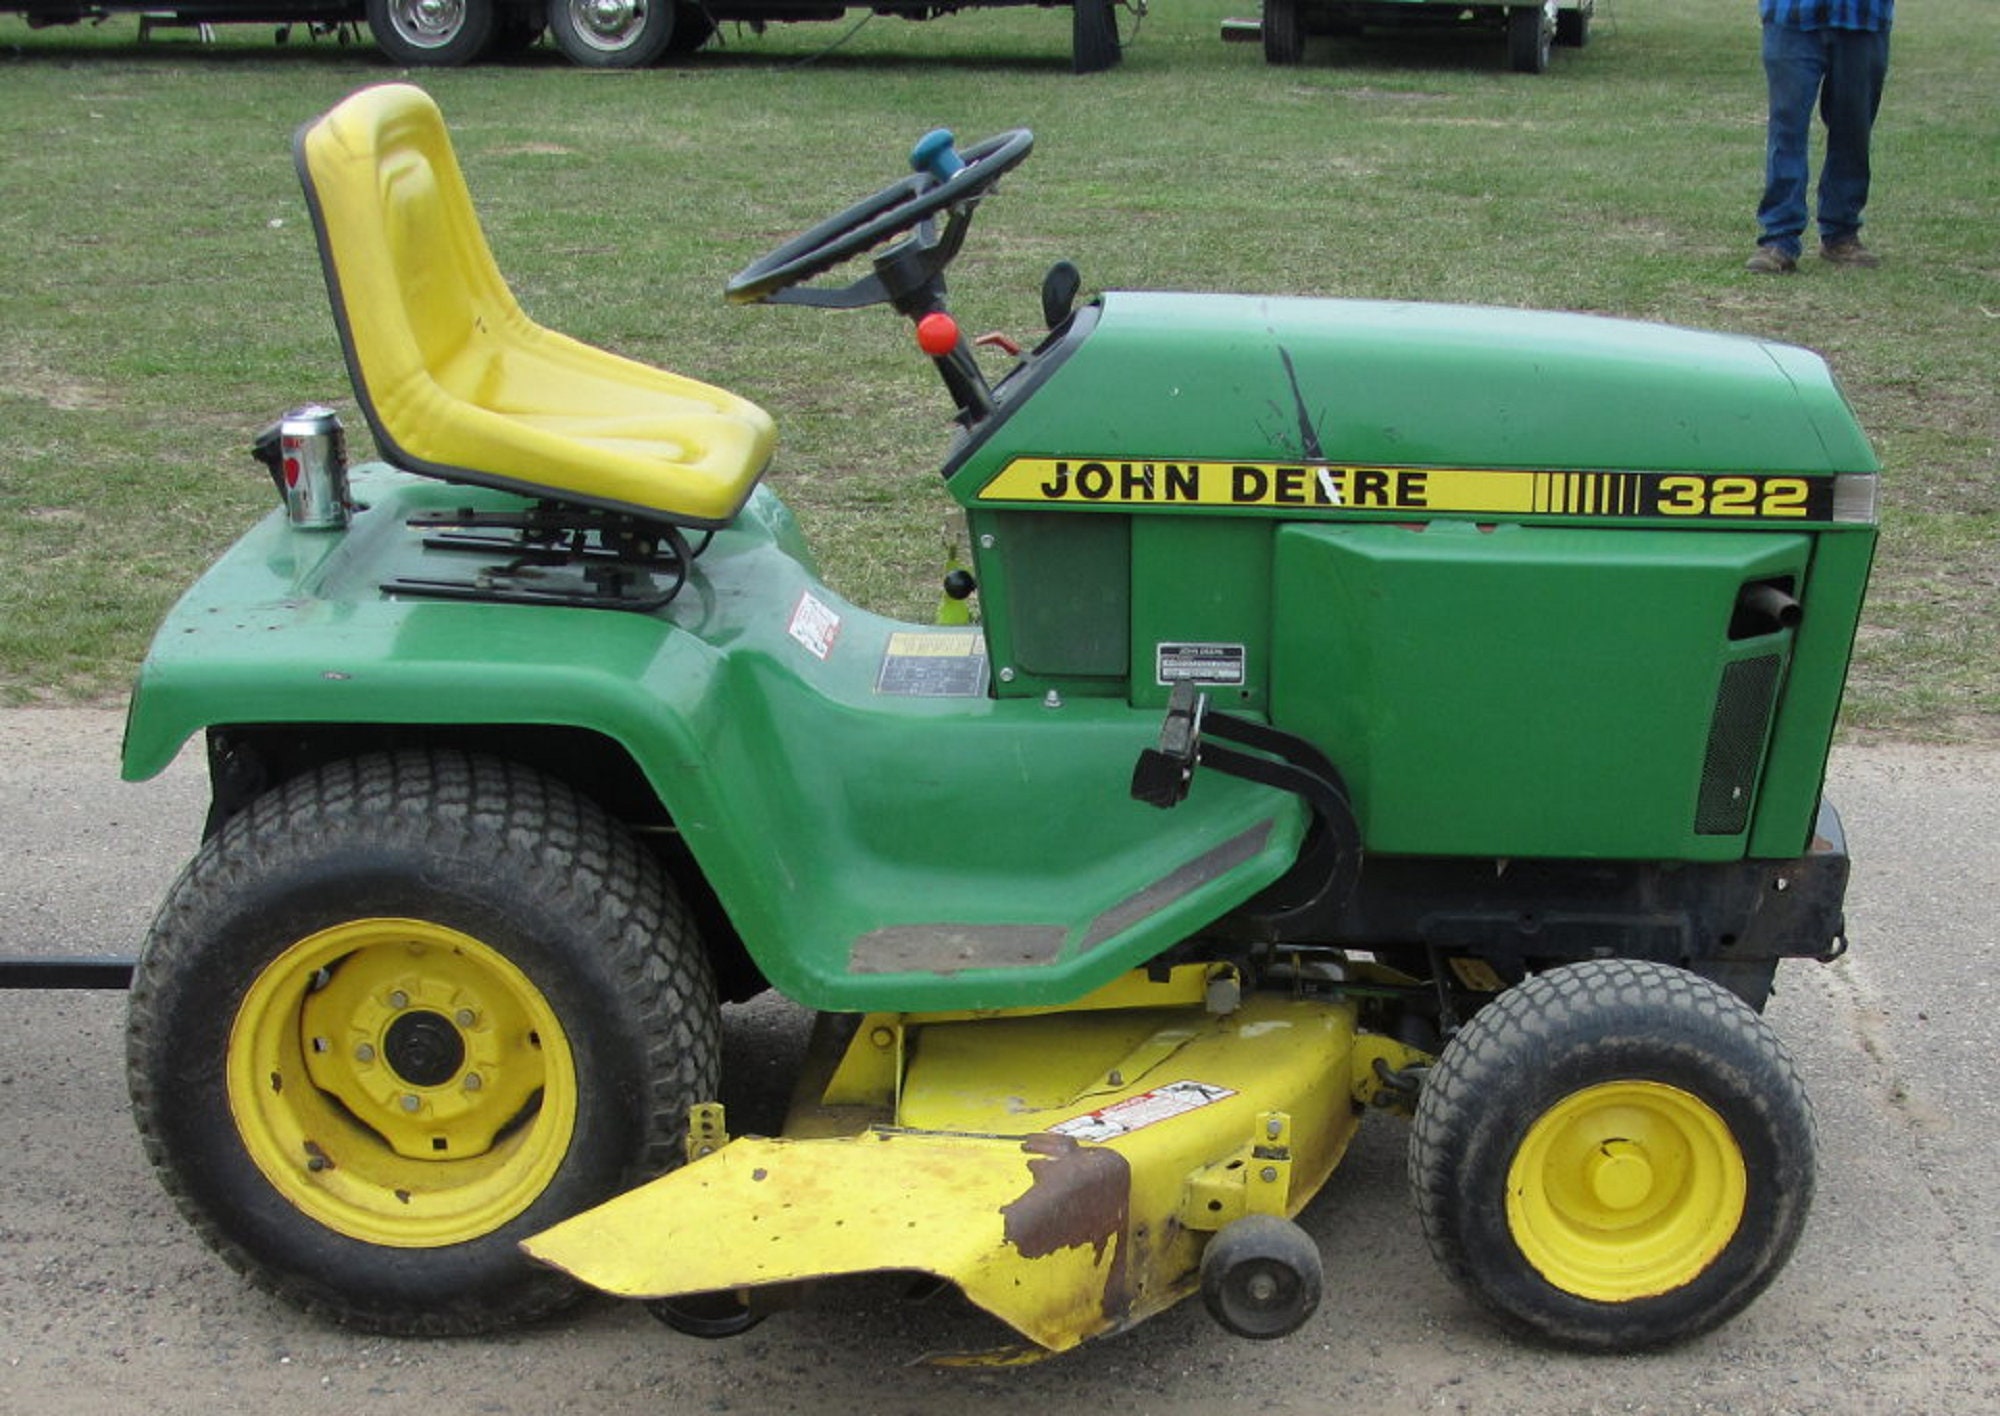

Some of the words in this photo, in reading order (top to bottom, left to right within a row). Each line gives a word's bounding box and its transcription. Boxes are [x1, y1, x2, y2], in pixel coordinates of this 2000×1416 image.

[1041, 462, 1199, 501] JOHN
[1232, 466, 1428, 507] DEERE
[1656, 476, 1810, 518] 322
